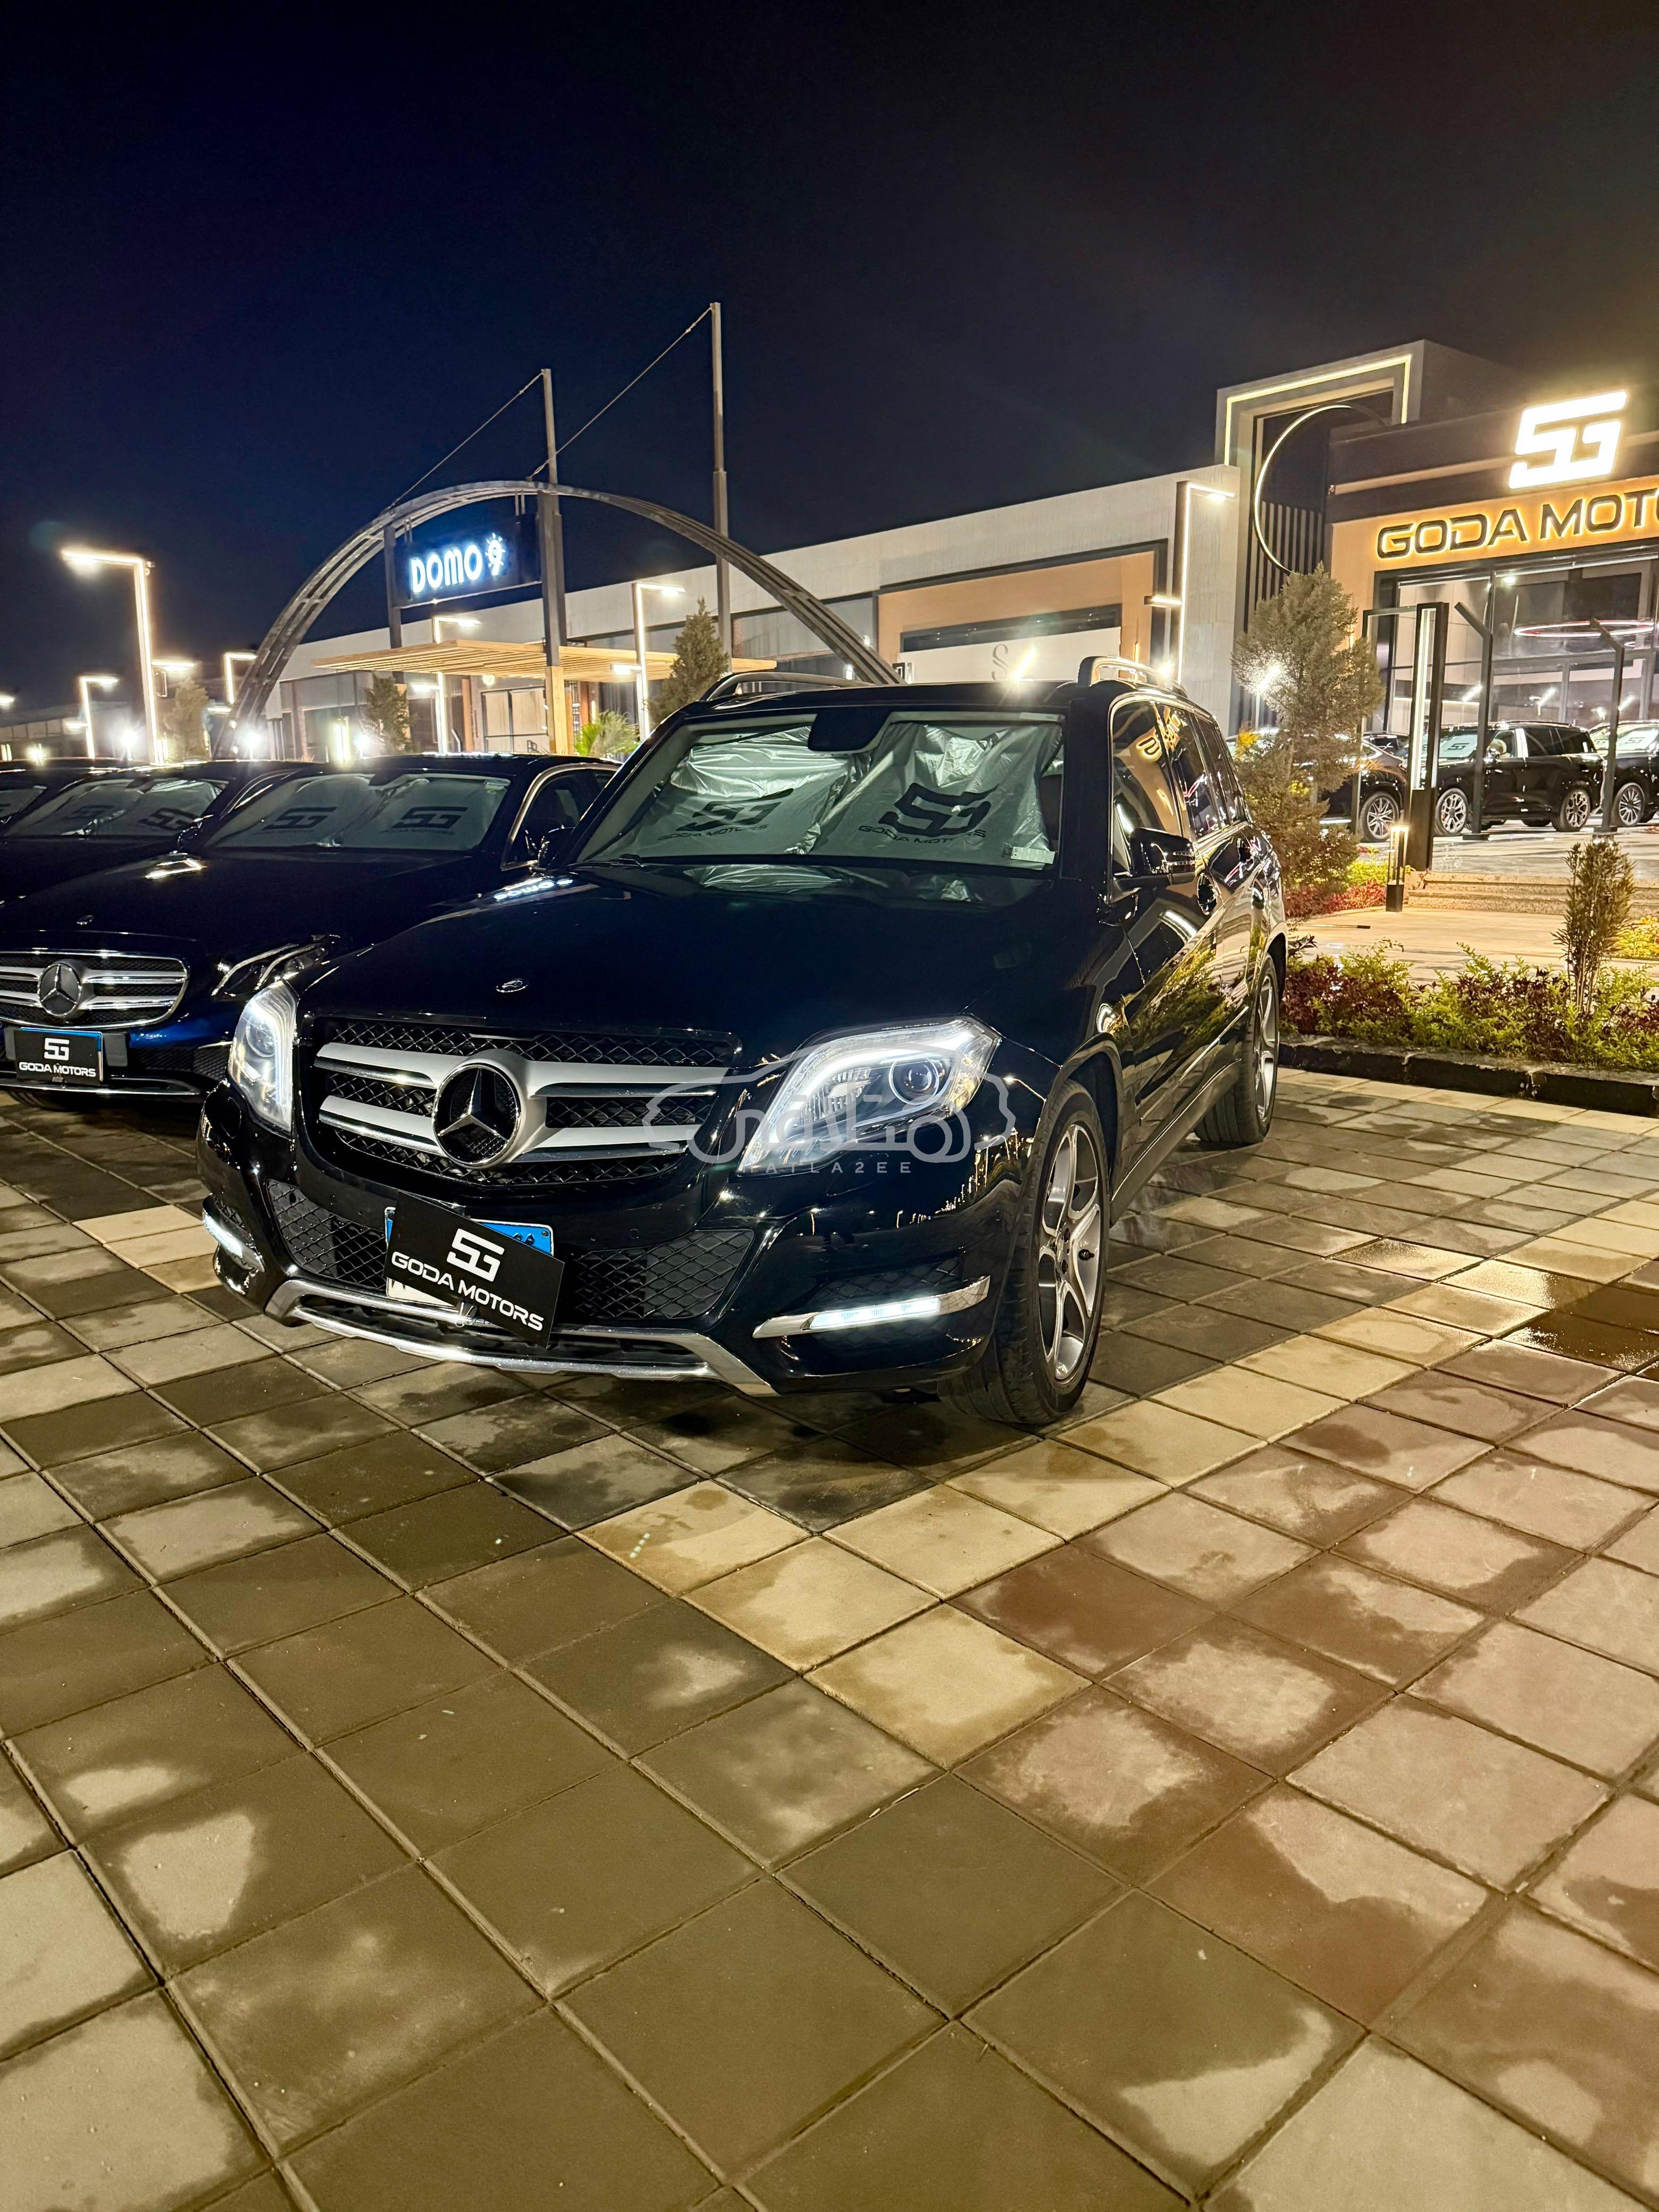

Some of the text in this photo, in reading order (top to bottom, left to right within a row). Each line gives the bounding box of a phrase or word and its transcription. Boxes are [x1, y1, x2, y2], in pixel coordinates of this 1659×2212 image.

[1377, 488, 1659, 559] GODA MOT
[411, 544, 482, 593] DOMO
[858, 825, 986, 844] GODA MOTS
[19, 1061, 96, 1077] GODA MOTORS
[391, 1251, 544, 1331] GODA MOTORS
